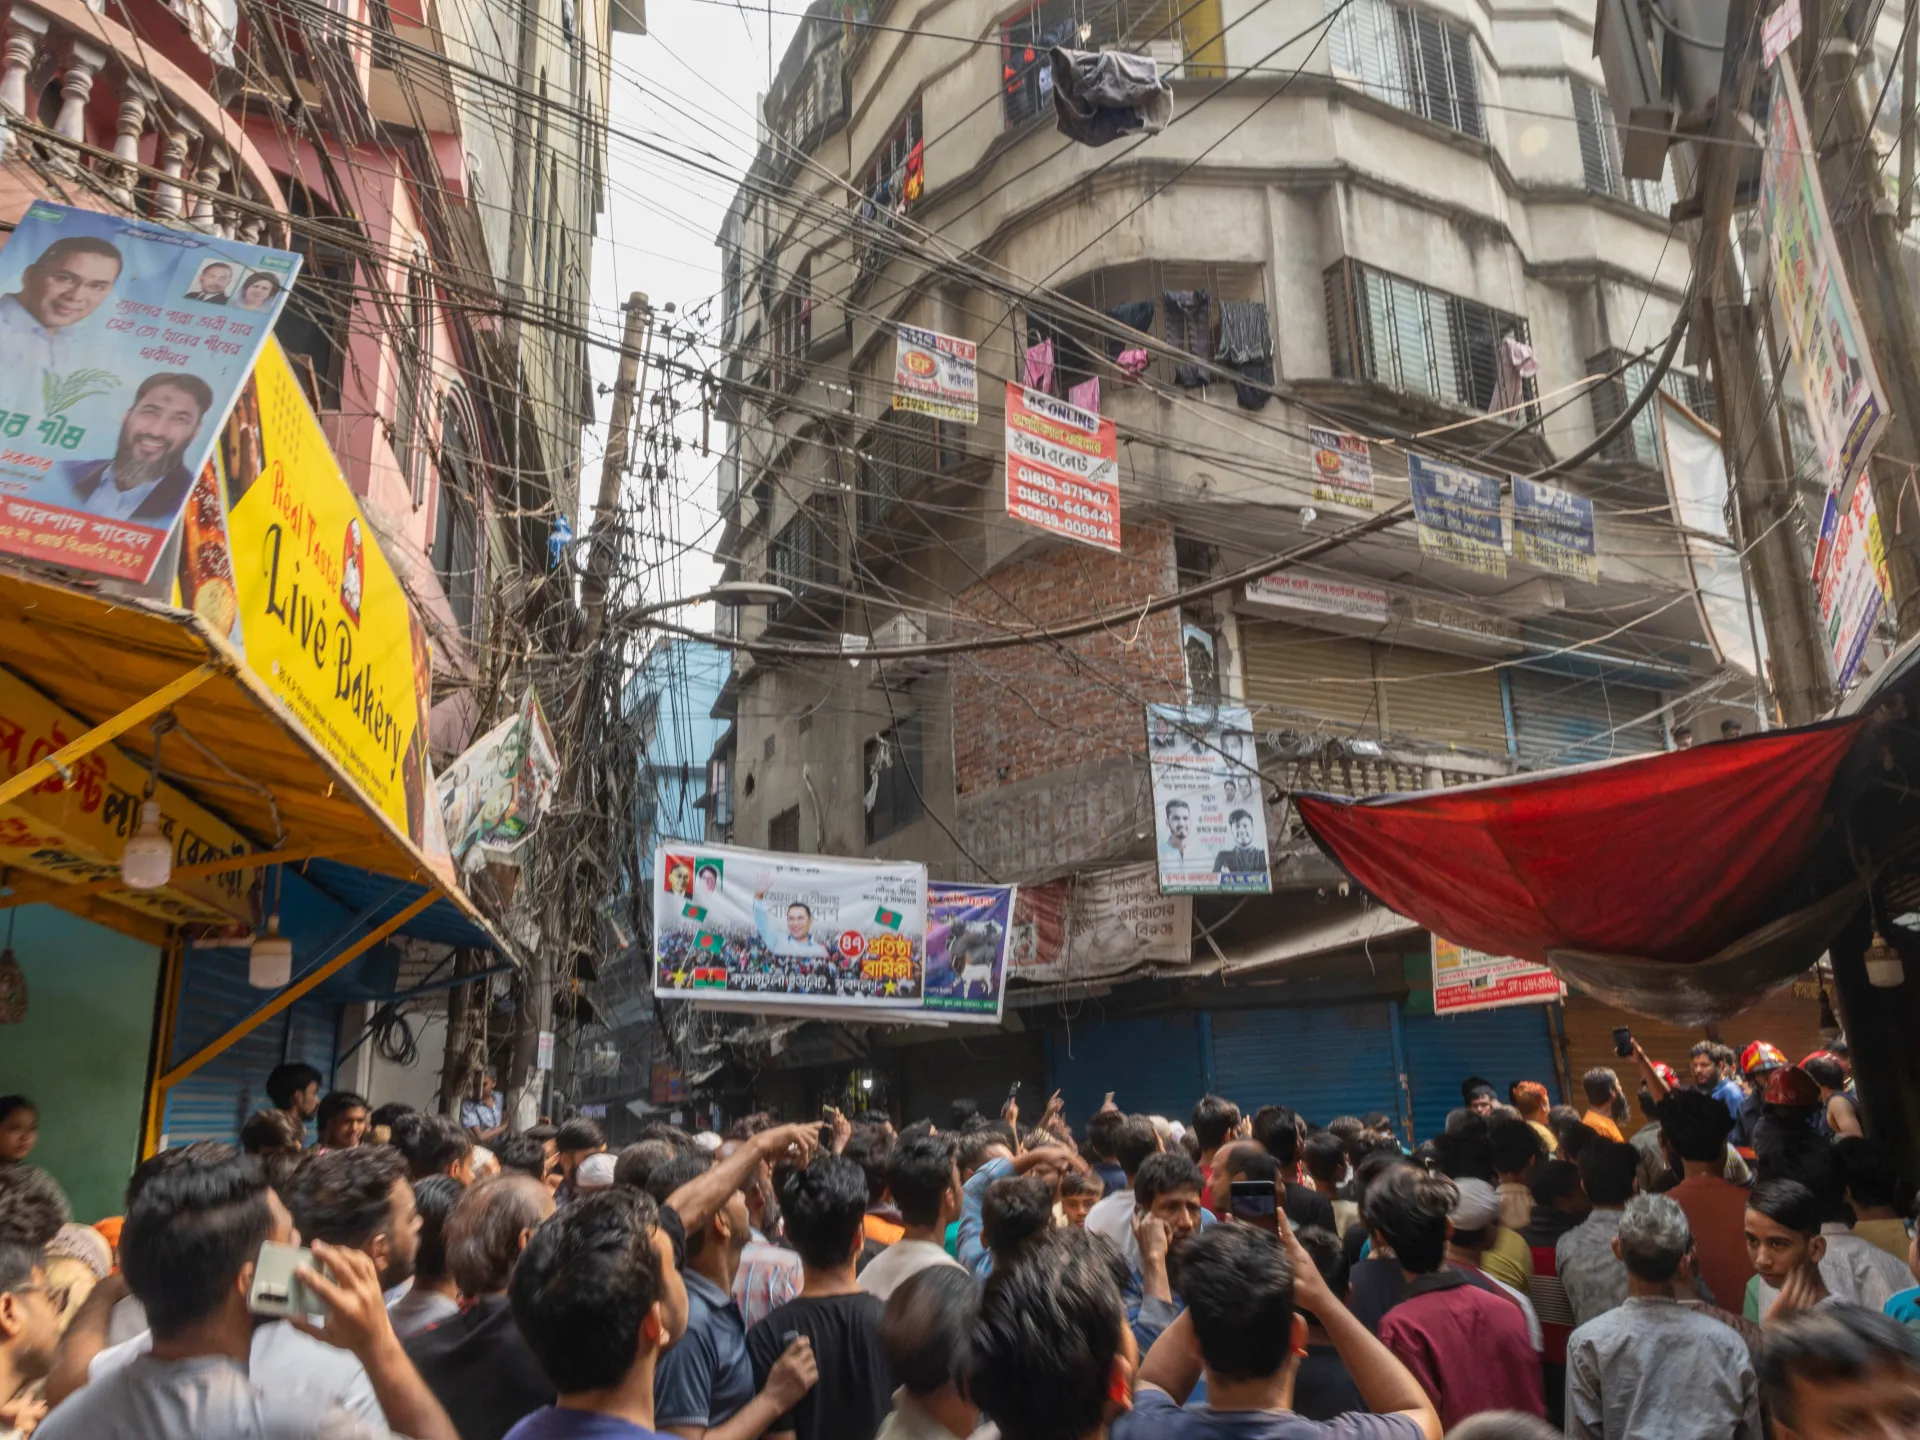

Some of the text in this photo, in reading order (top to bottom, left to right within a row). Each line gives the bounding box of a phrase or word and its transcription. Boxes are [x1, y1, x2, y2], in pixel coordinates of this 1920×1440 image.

[162, 327, 202, 348] ধানের
[204, 334, 245, 357] শীষের
[228, 322, 255, 337] যার
[898, 327, 976, 360] SMS NET
[1029, 395, 1095, 431] AS ONLINE
[36, 415, 87, 450] শীষ
[1311, 429, 1338, 448] SMS
[271, 460, 339, 595] Real Taste
[263, 523, 327, 670] Live
[333, 620, 402, 782] Bakery
[842, 936, 862, 954] ৪৭
[868, 934, 912, 957] প্রতিষ্ঠা
[864, 958, 912, 980] বার্ষিকী
